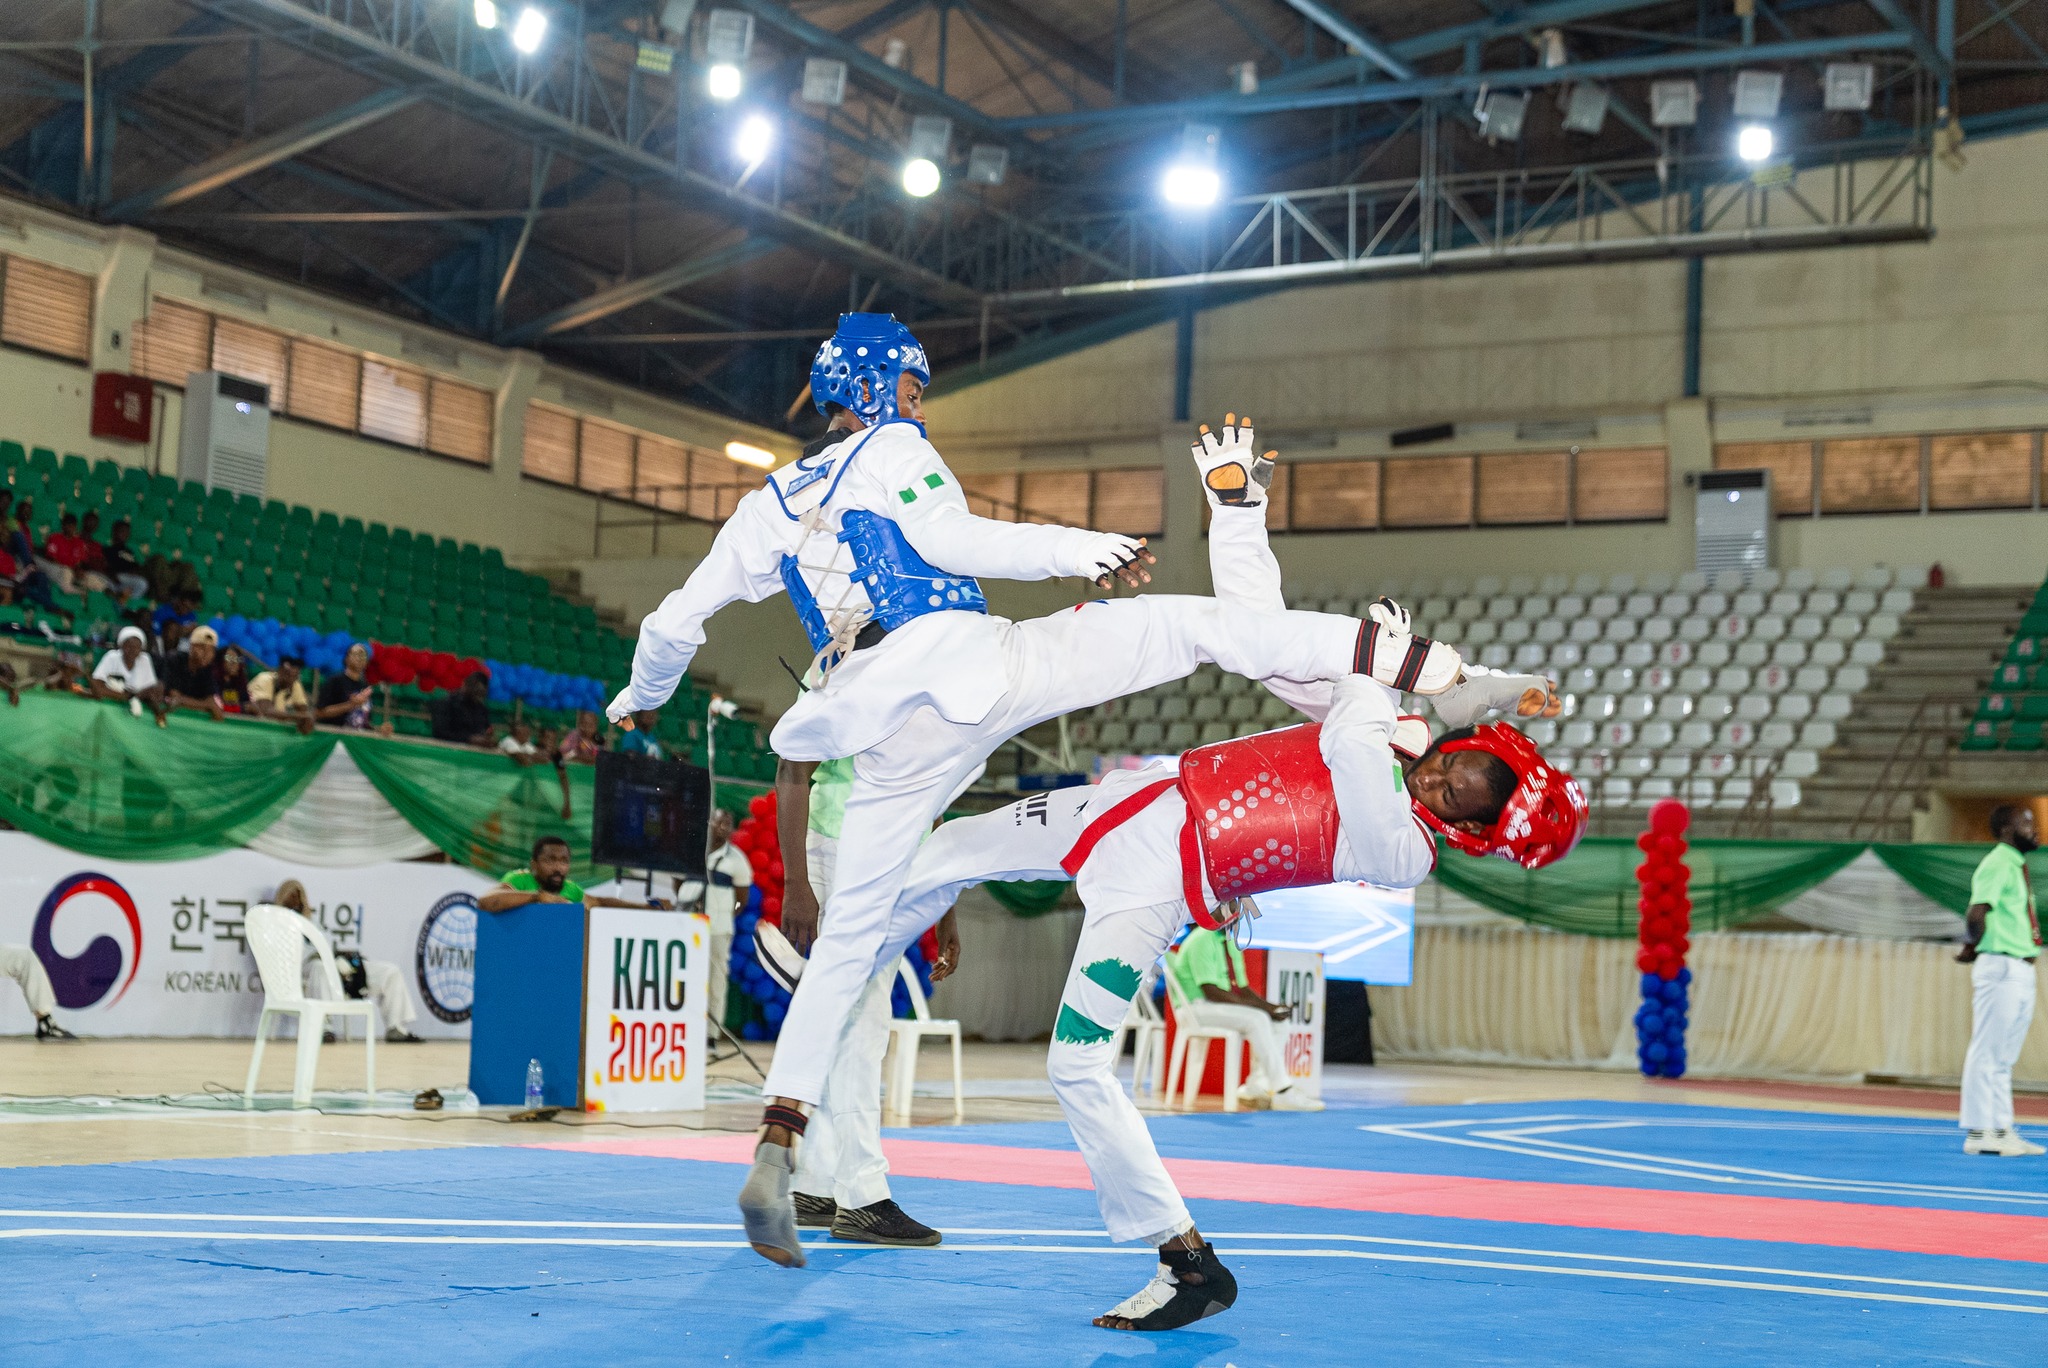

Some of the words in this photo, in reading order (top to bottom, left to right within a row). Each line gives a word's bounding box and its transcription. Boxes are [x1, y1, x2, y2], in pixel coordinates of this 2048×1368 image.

[170, 895, 364, 955] 한국원
[165, 970, 242, 994] KOREAN
[427, 944, 475, 970] WTM
[612, 937, 687, 1012] KAC
[1280, 970, 1313, 1025] KAC
[608, 1021, 686, 1083] 2025
[1285, 1032, 1312, 1077] 025
